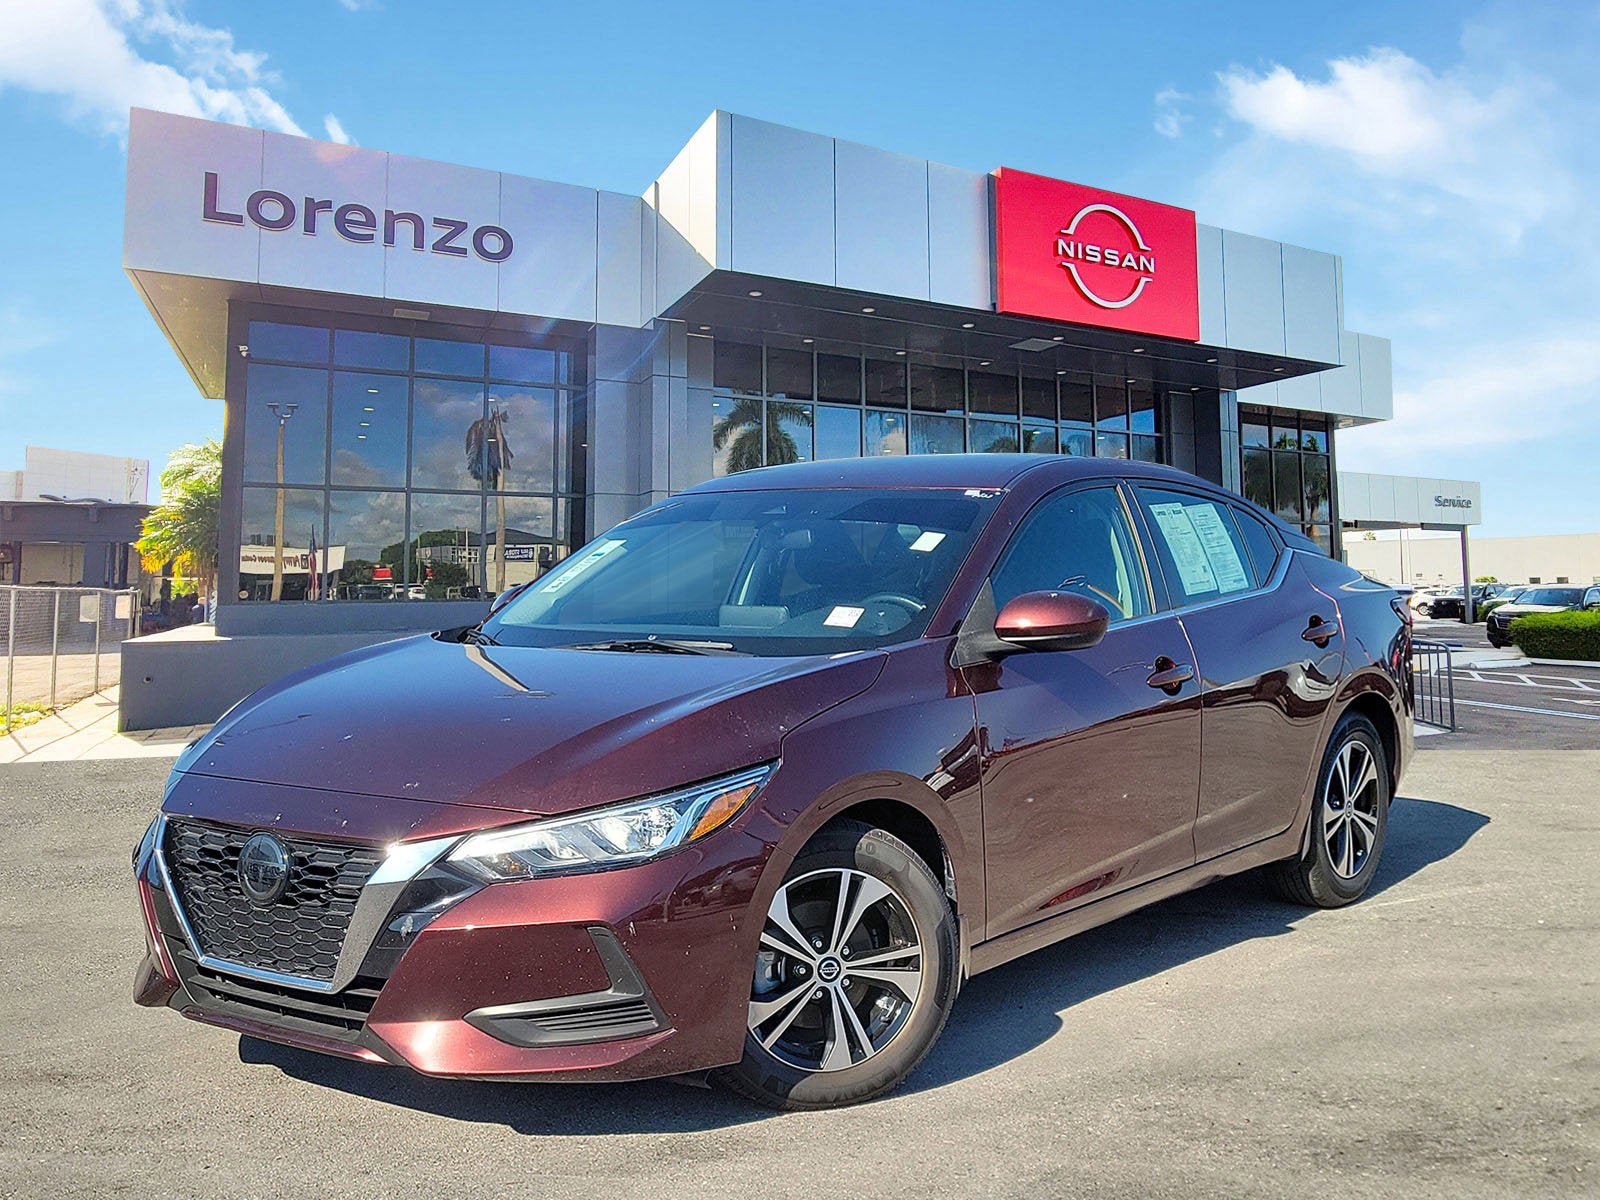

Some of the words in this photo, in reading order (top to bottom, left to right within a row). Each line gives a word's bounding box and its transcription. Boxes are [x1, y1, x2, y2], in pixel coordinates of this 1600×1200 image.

[203, 171, 514, 262] Lorenzo
[1057, 238, 1155, 273] NISSAN
[1434, 495, 1472, 508] Service
